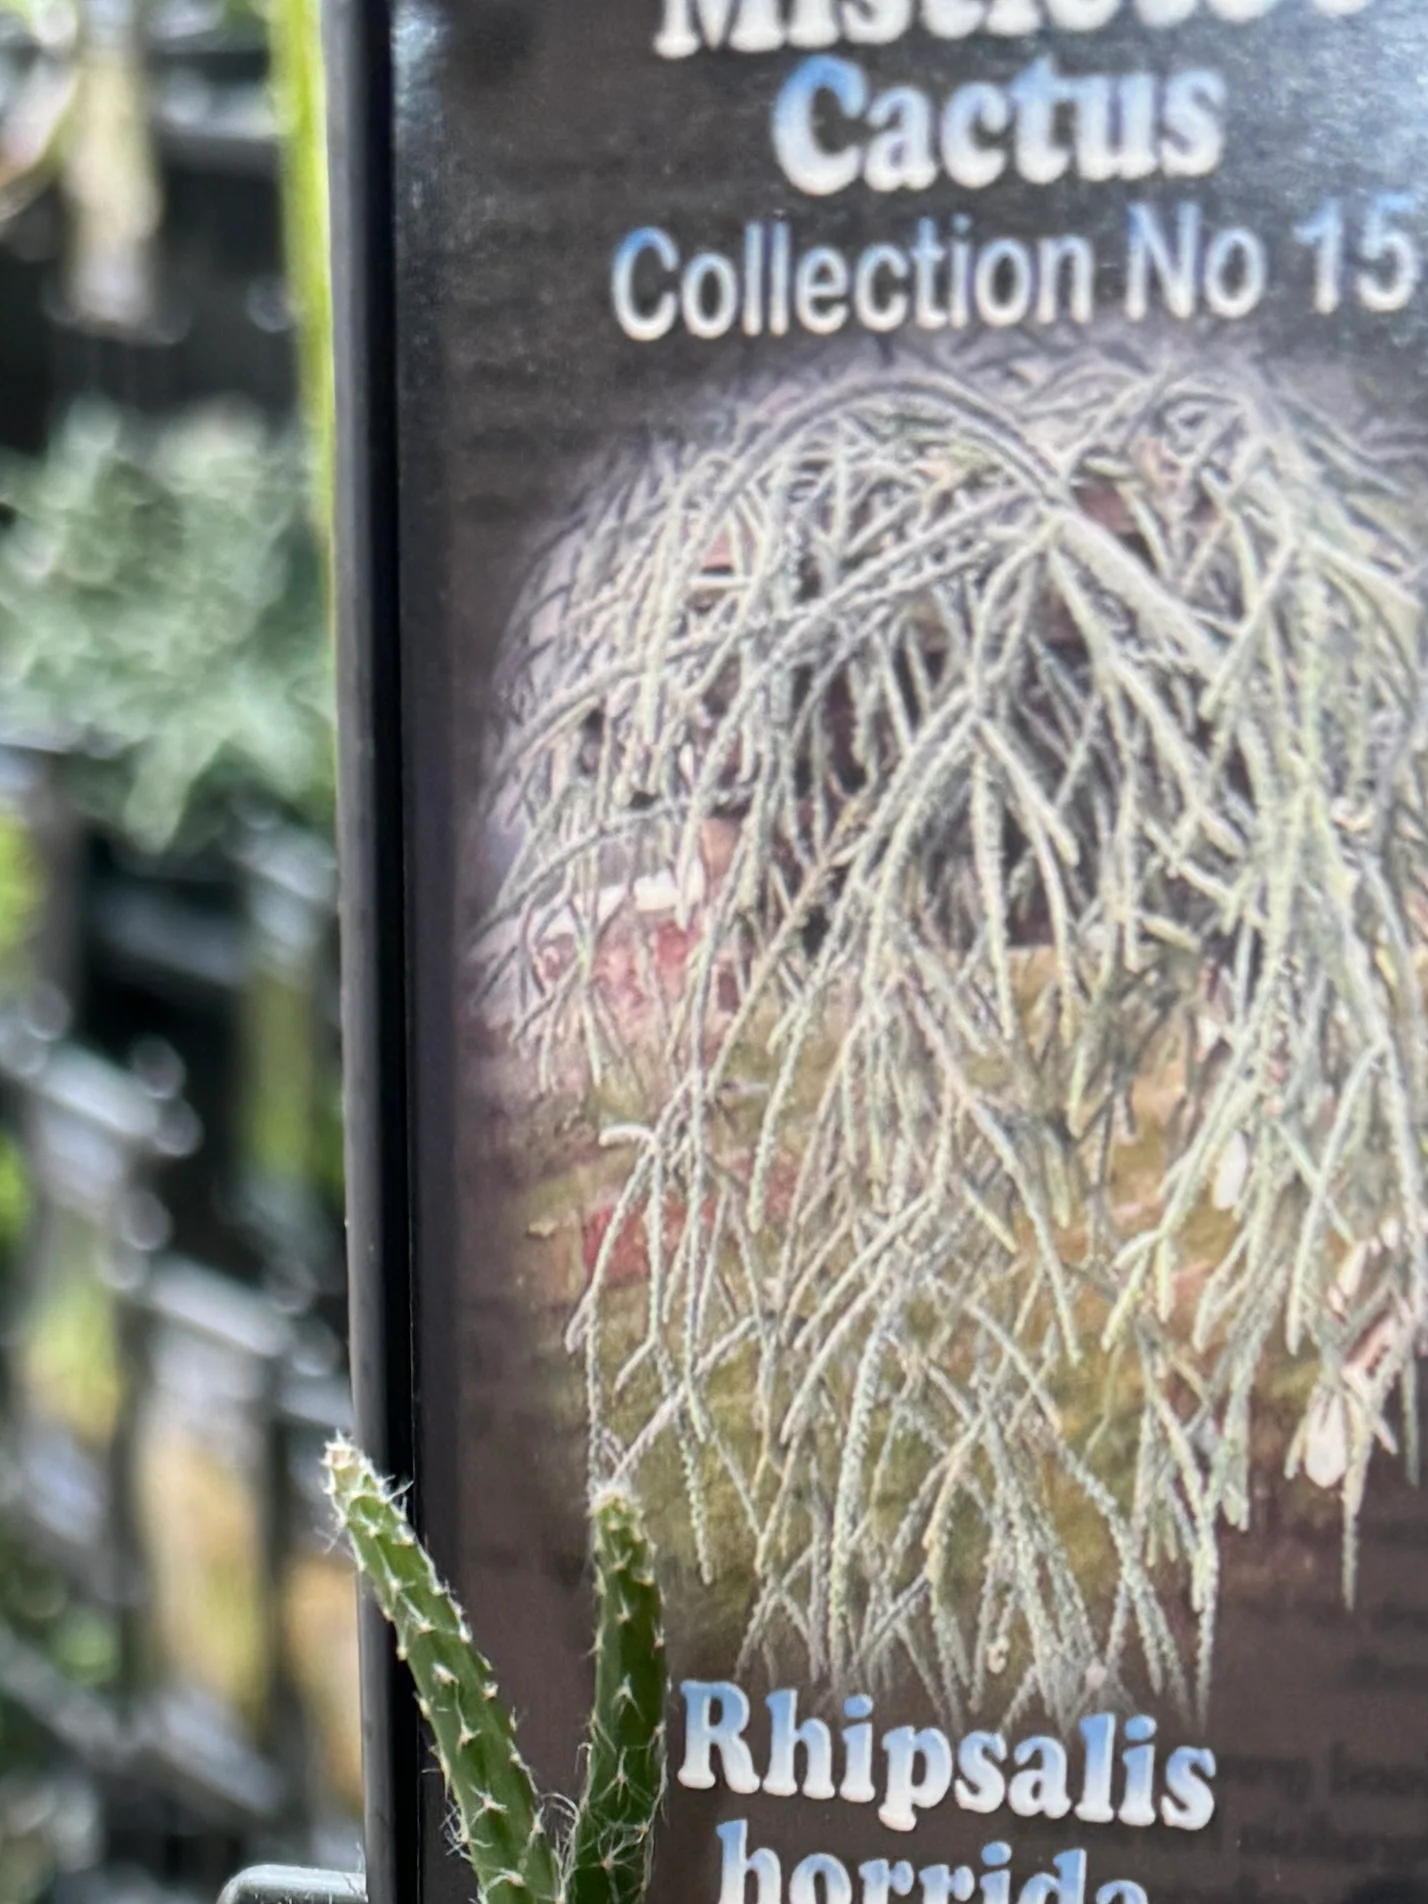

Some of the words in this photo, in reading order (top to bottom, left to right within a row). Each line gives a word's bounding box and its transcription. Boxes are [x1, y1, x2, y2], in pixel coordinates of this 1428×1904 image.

[774, 55, 1226, 195] Cactus
[612, 216, 1094, 340] Collection
[1125, 202, 1264, 318] No
[1294, 196, 1418, 312] 15
[679, 1680, 1216, 1831] Rhipsalis
